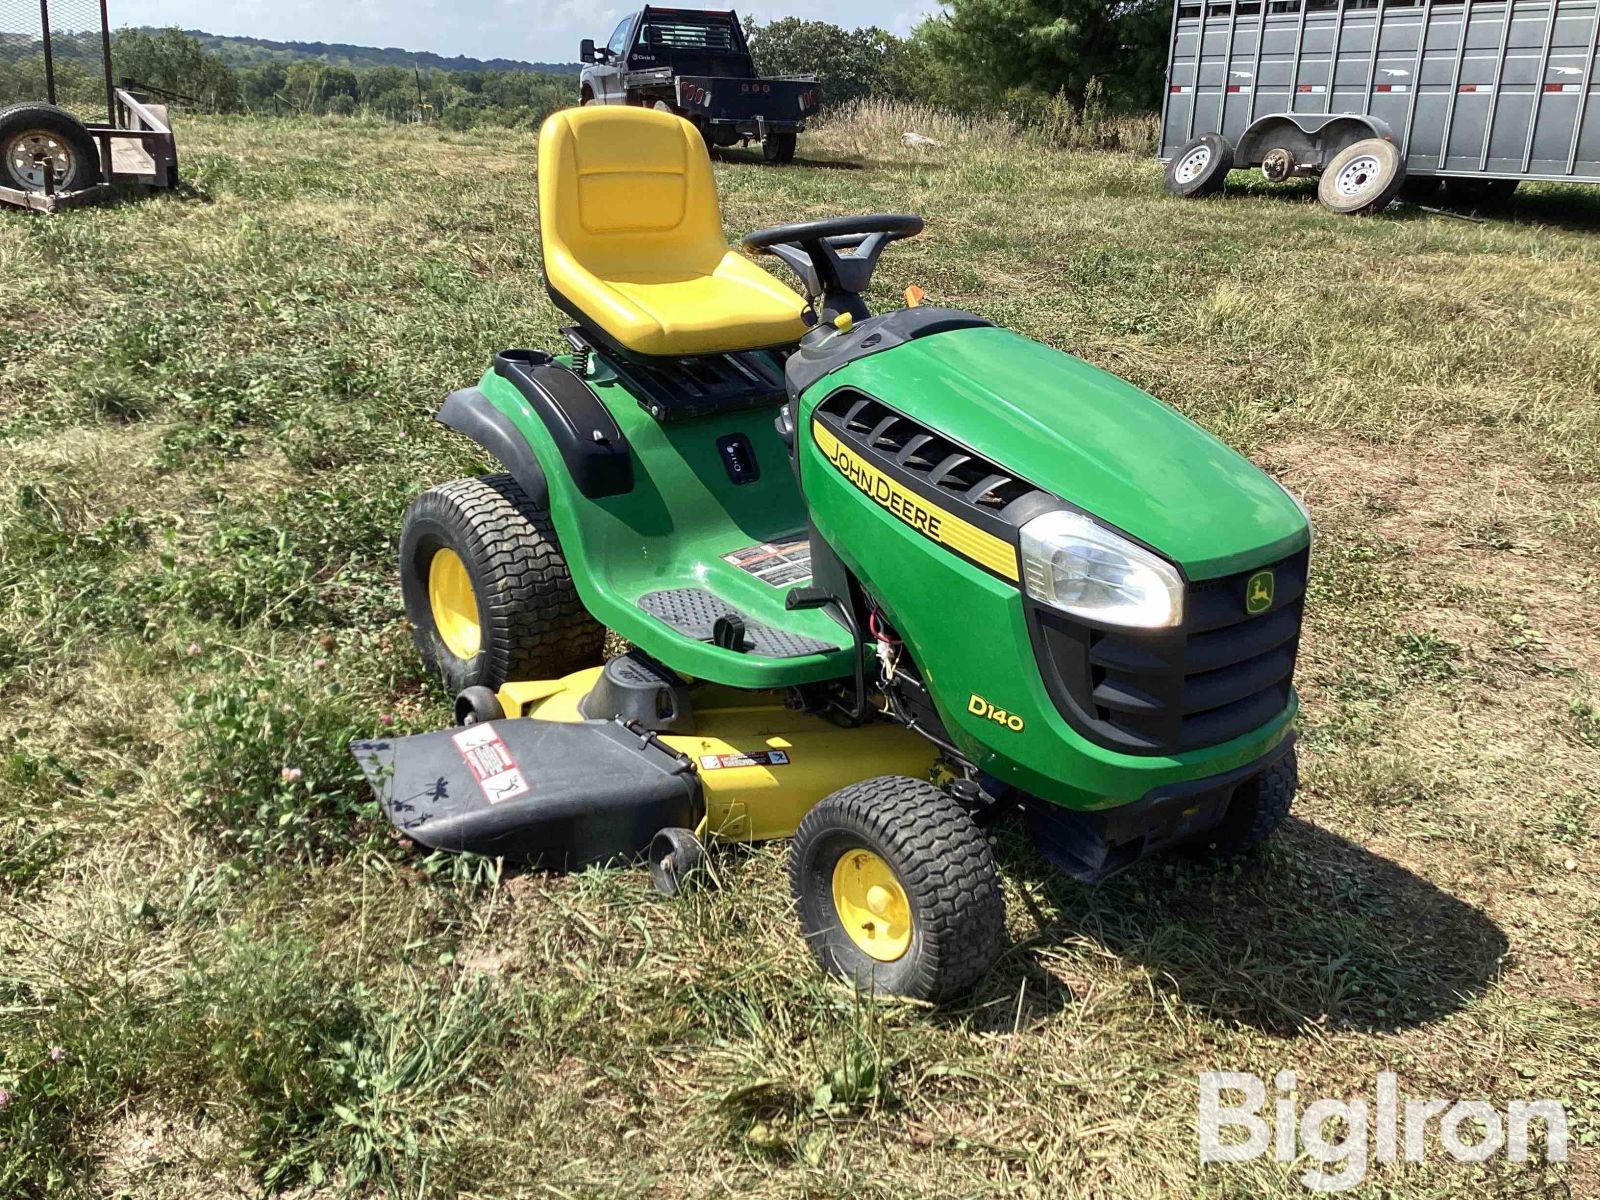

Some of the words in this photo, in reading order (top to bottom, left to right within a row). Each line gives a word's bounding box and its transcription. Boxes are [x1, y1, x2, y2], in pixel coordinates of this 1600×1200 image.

[829, 442, 873, 493] JOHN
[875, 478, 942, 539] DEERE
[967, 693, 1025, 733] D140
